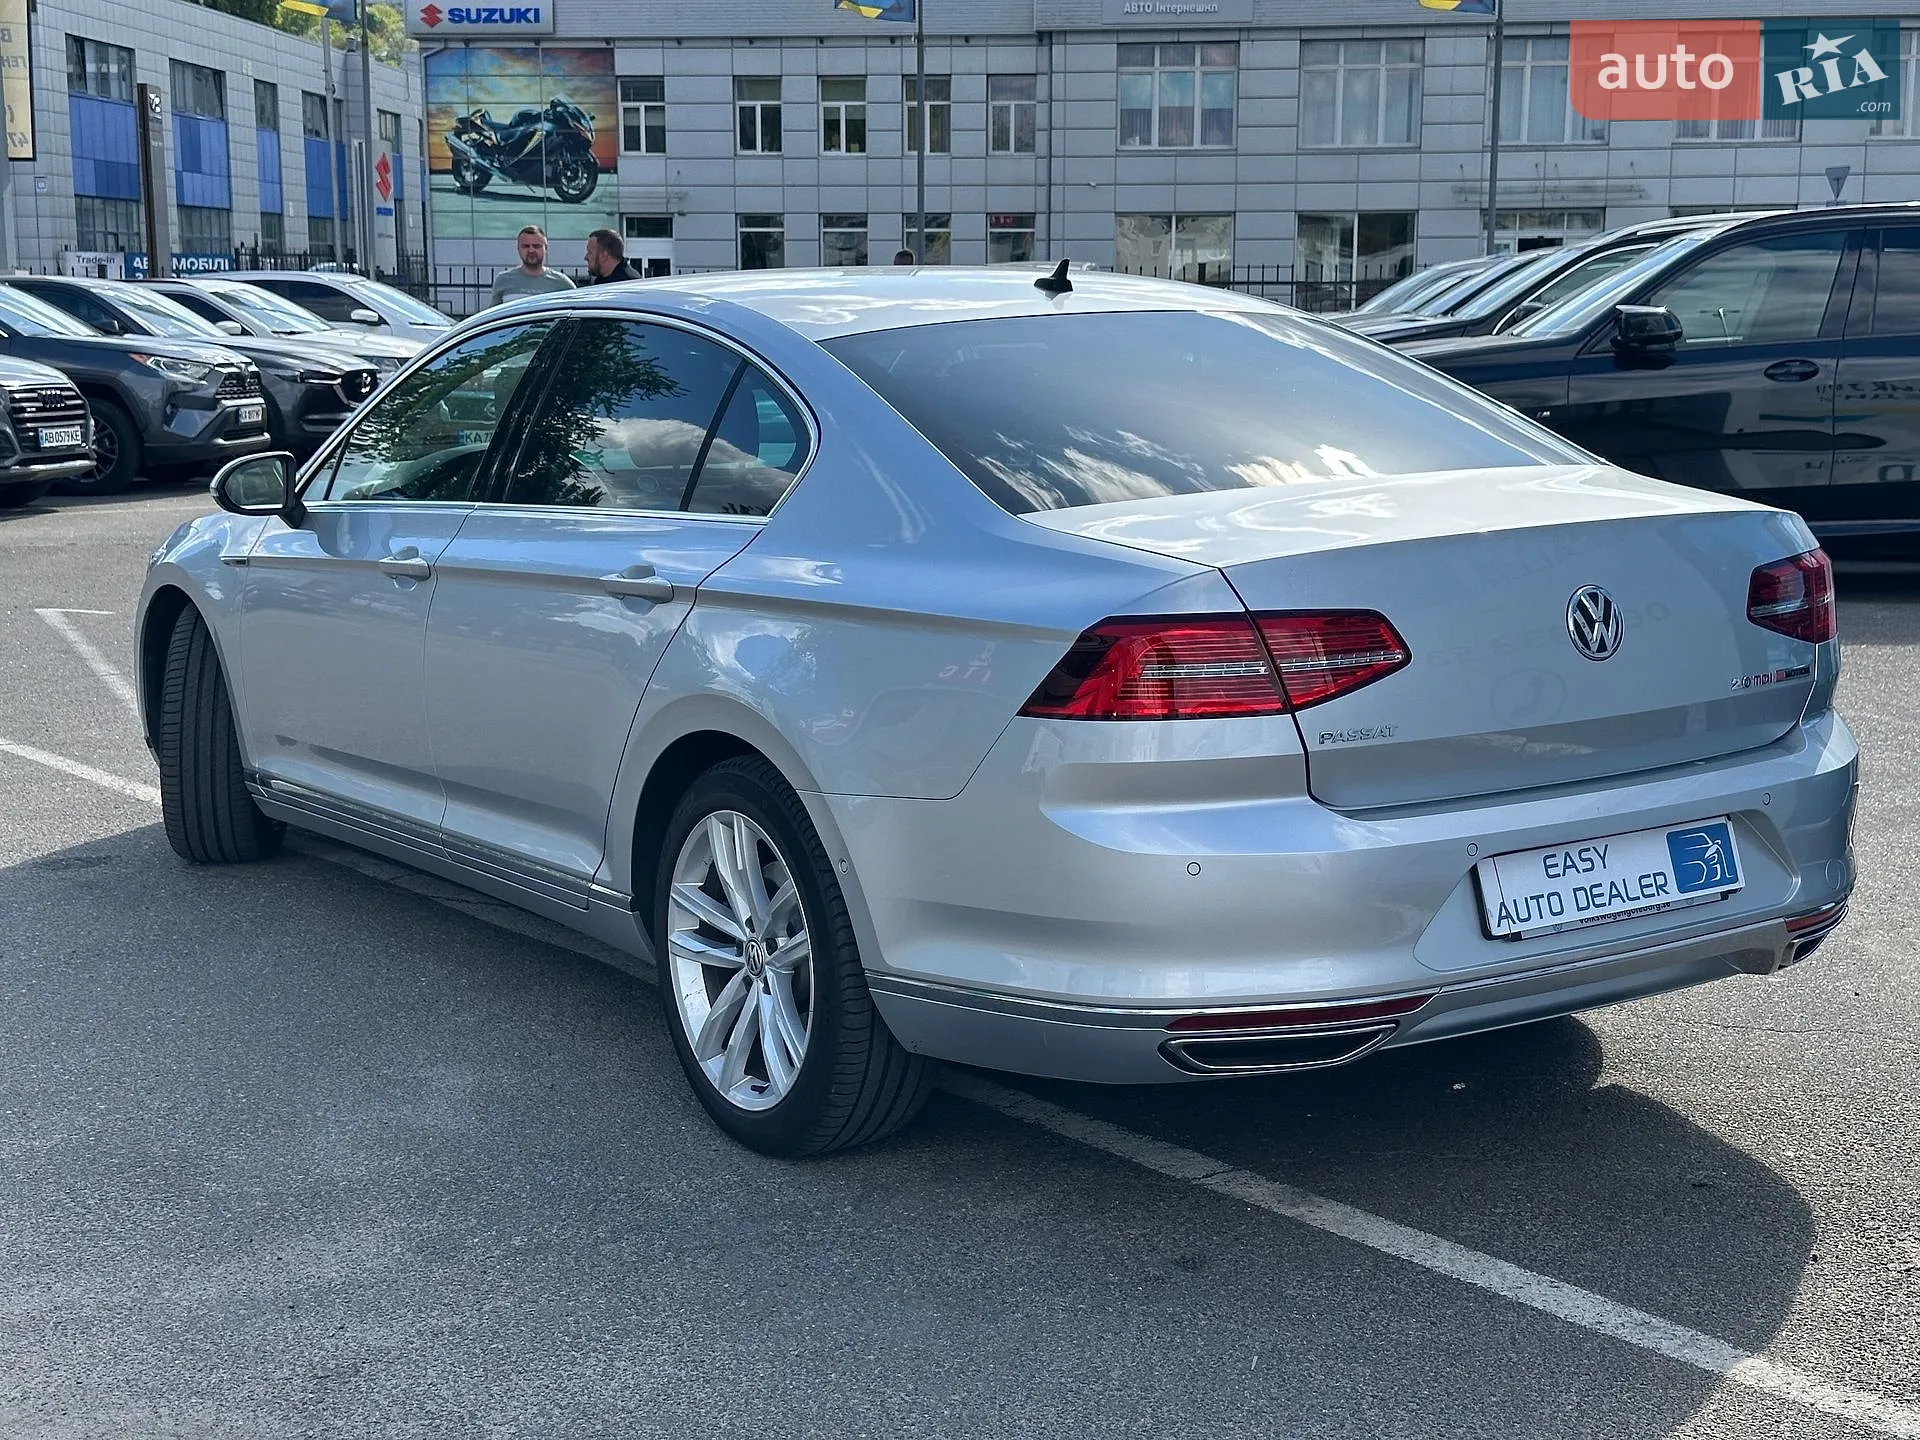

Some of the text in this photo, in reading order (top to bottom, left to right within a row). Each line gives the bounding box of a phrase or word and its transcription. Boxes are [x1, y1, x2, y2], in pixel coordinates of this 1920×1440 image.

[447, 7, 540, 24] SUZUKI
[1123, 2, 1152, 14] АВТО
[76, 254, 116, 265] Trade-in
[1319, 725, 1398, 744] PASSAT
[1542, 844, 1609, 879] EASY
[1496, 871, 1671, 928] AUTO DEALER
